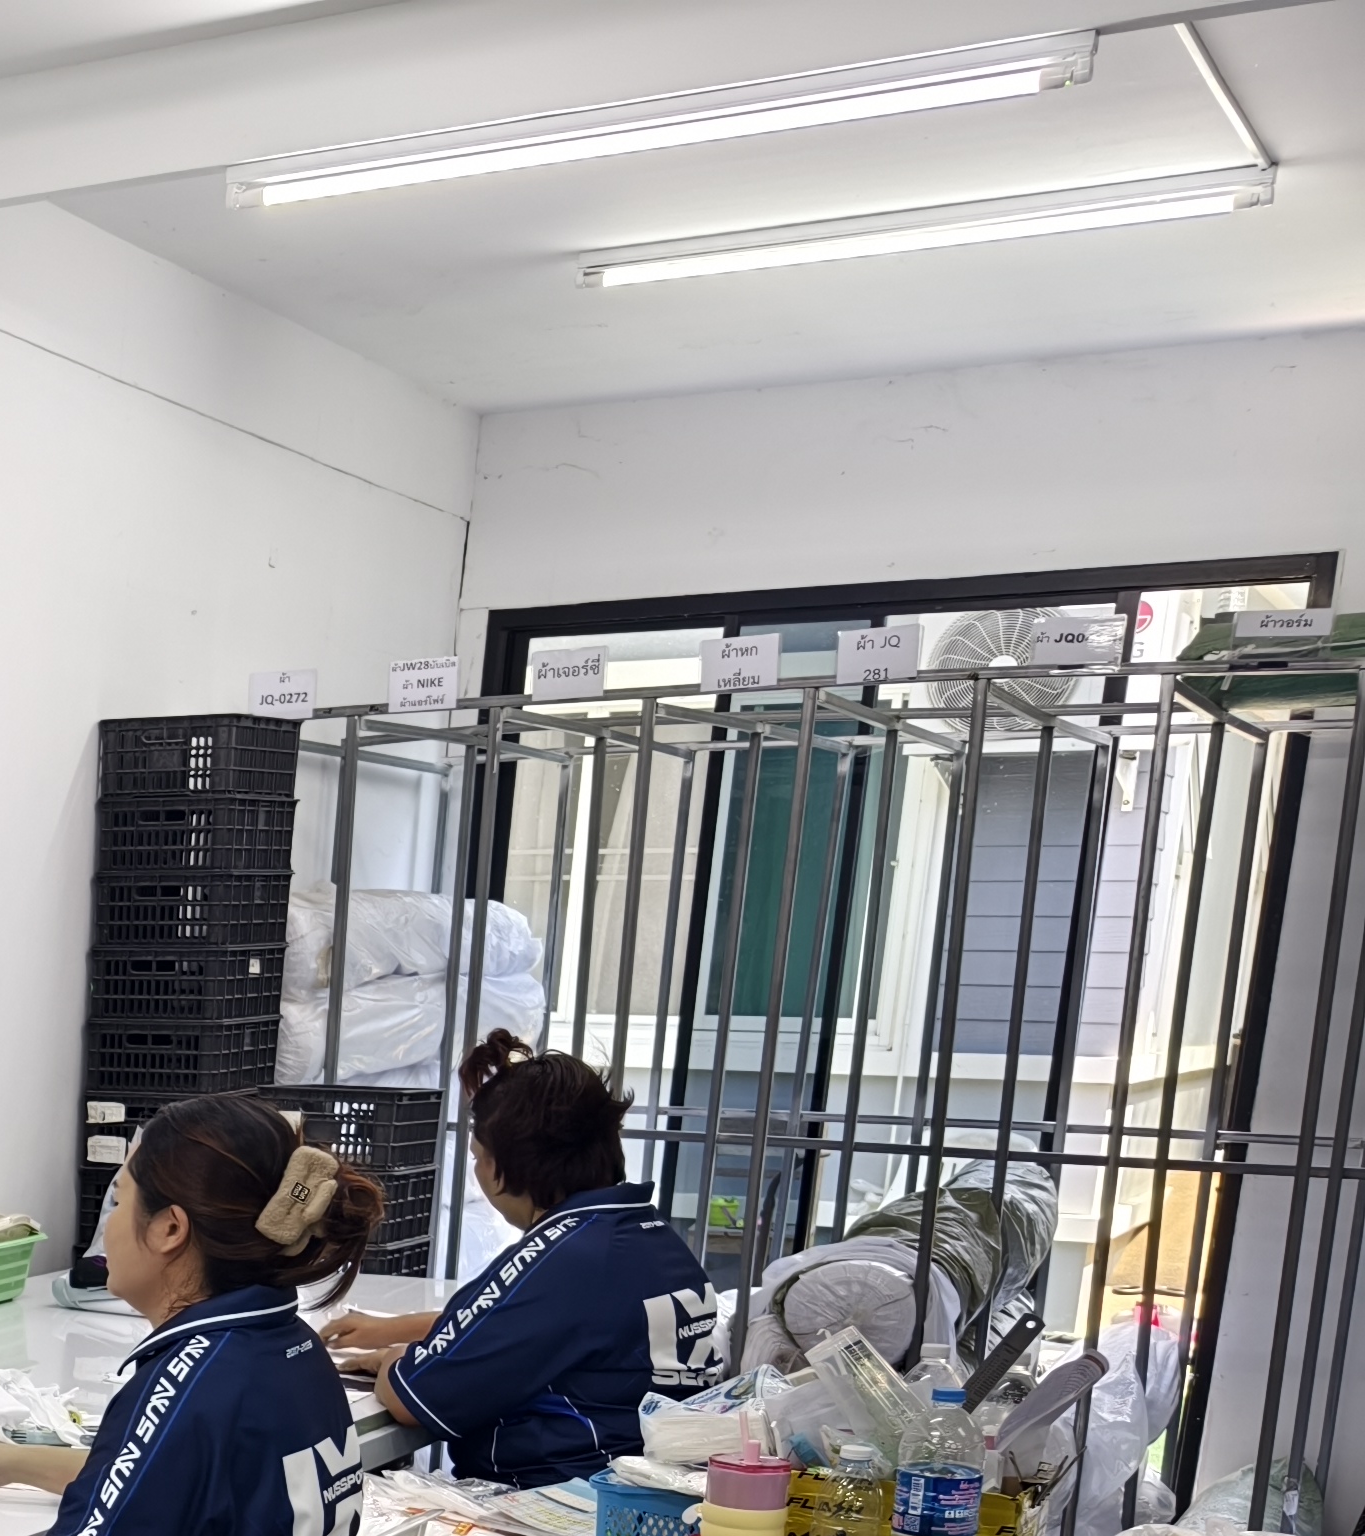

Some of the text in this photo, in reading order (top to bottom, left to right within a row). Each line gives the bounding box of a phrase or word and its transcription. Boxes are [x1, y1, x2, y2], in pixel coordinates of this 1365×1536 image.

[1260, 613, 1313, 630] ผ้าวอร์ม
[856, 634, 902, 651] ผ้า JQ
[1035, 631, 1050, 644] ผ้า
[720, 642, 759, 660] ผ้าหก
[279, 671, 291, 684] ผ้า
[862, 666, 890, 682] 281
[402, 676, 445, 690] ผ้า NIKE
[258, 691, 310, 707] JQ-0272
